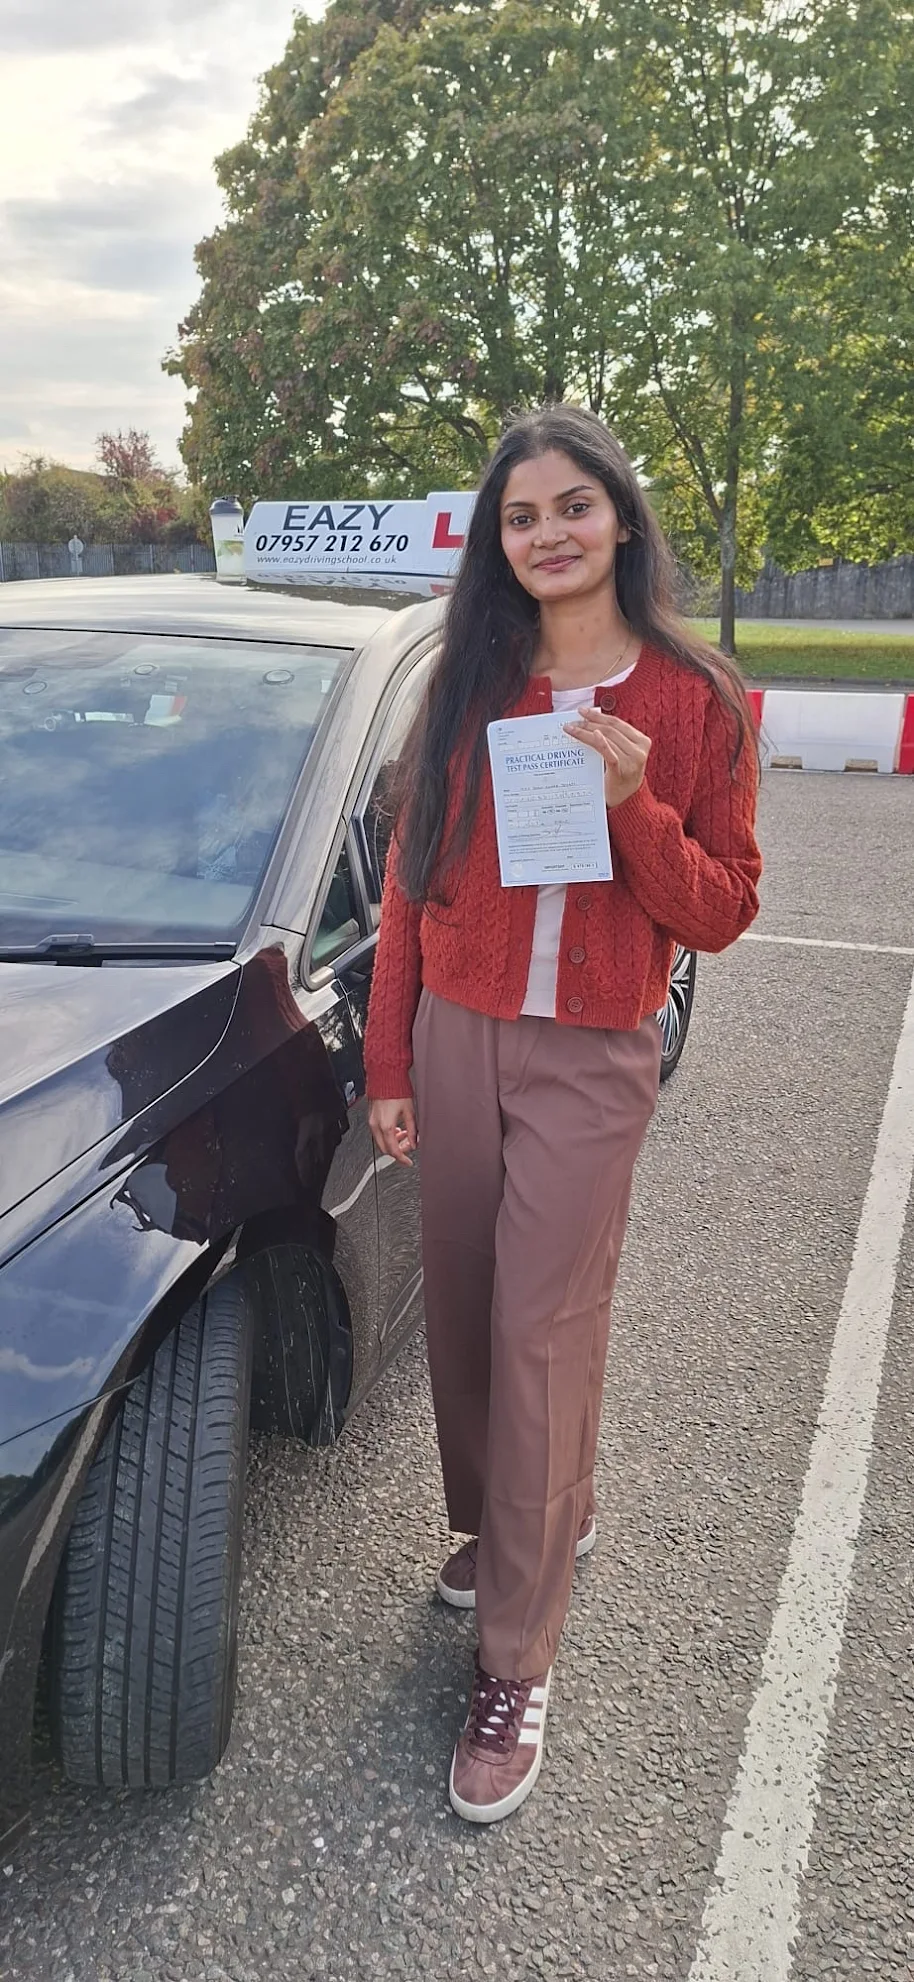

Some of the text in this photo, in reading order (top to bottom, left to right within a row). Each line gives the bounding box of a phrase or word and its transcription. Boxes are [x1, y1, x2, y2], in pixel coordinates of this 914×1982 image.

[282, 504, 395, 531] EAZY
[432, 511, 465, 549] L
[255, 534, 409, 552] 07957 212 670
[256, 554, 397, 566] www.eazydrivingschool.couk
[505, 748, 585, 765] PRACTICAL DRIVING
[507, 757, 586, 773] TEST PASS CERTIFICATE
